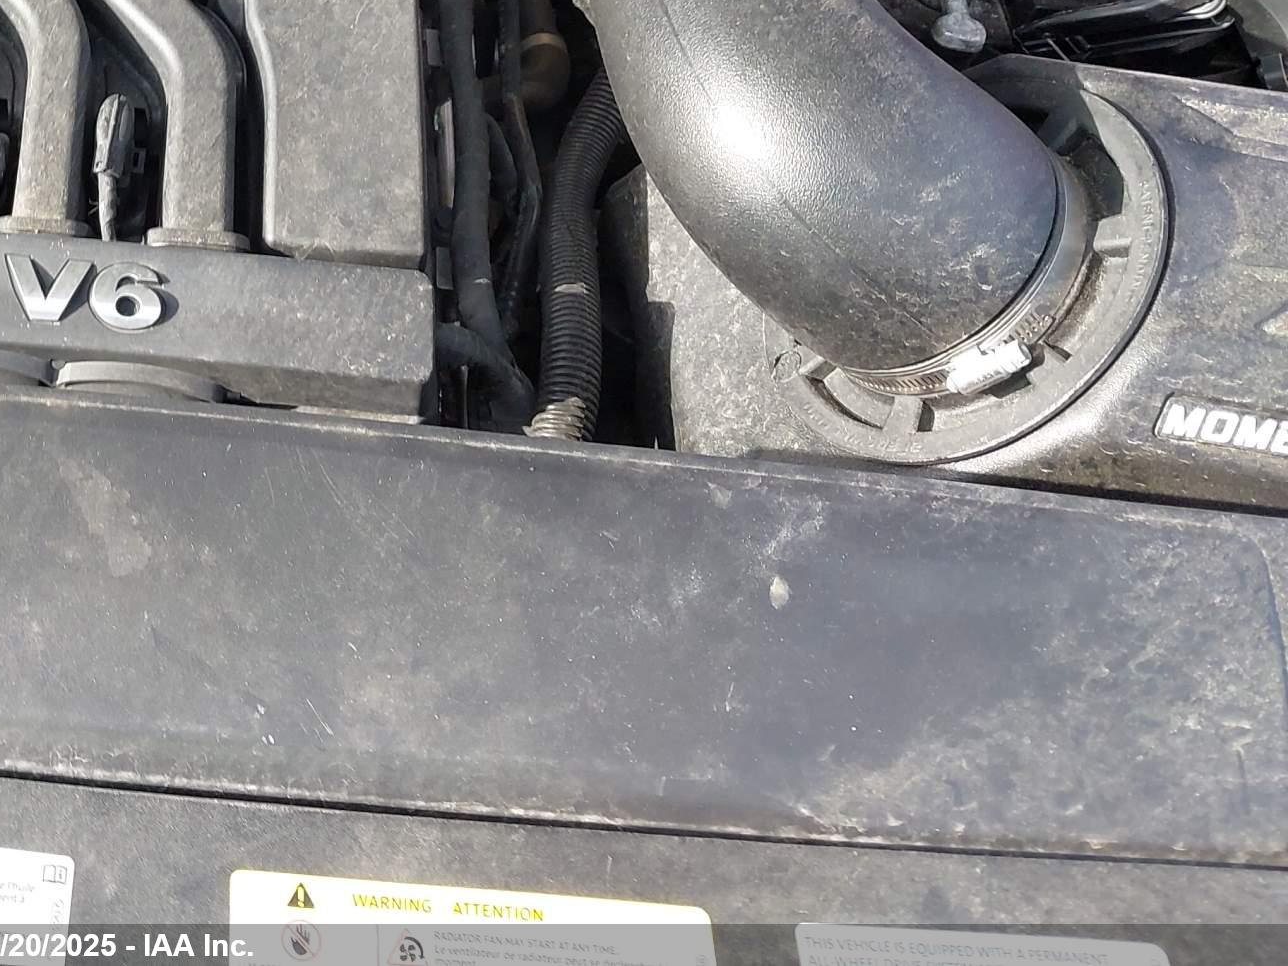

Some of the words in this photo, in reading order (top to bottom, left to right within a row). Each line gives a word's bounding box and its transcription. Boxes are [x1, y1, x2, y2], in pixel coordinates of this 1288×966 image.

[4, 252, 167, 334] V6
[351, 892, 432, 915] WARNING
[452, 900, 545, 922] ATTENTION
[433, 930, 481, 945] RADIATOR
[484, 935, 503, 946] FAN
[505, 937, 524, 948] MAY
[527, 938, 555, 950] START
[559, 941, 570, 951] AT
[572, 943, 590, 953] ANY
[434, 945, 447, 955] Le
[448, 946, 500, 960] ventilateur
[503, 951, 516, 961] de
[518, 953, 562, 964] radiateur
[804, 936, 833, 951] THIS
[835, 938, 892, 953] VEHICLE
[894, 940, 905, 954] IS
[908, 942, 975, 958] EQUIPPED
[977, 945, 1011, 959] WITH
[1015, 948, 1025, 960] A
[1027, 949, 1109, 965] PERMANENT
